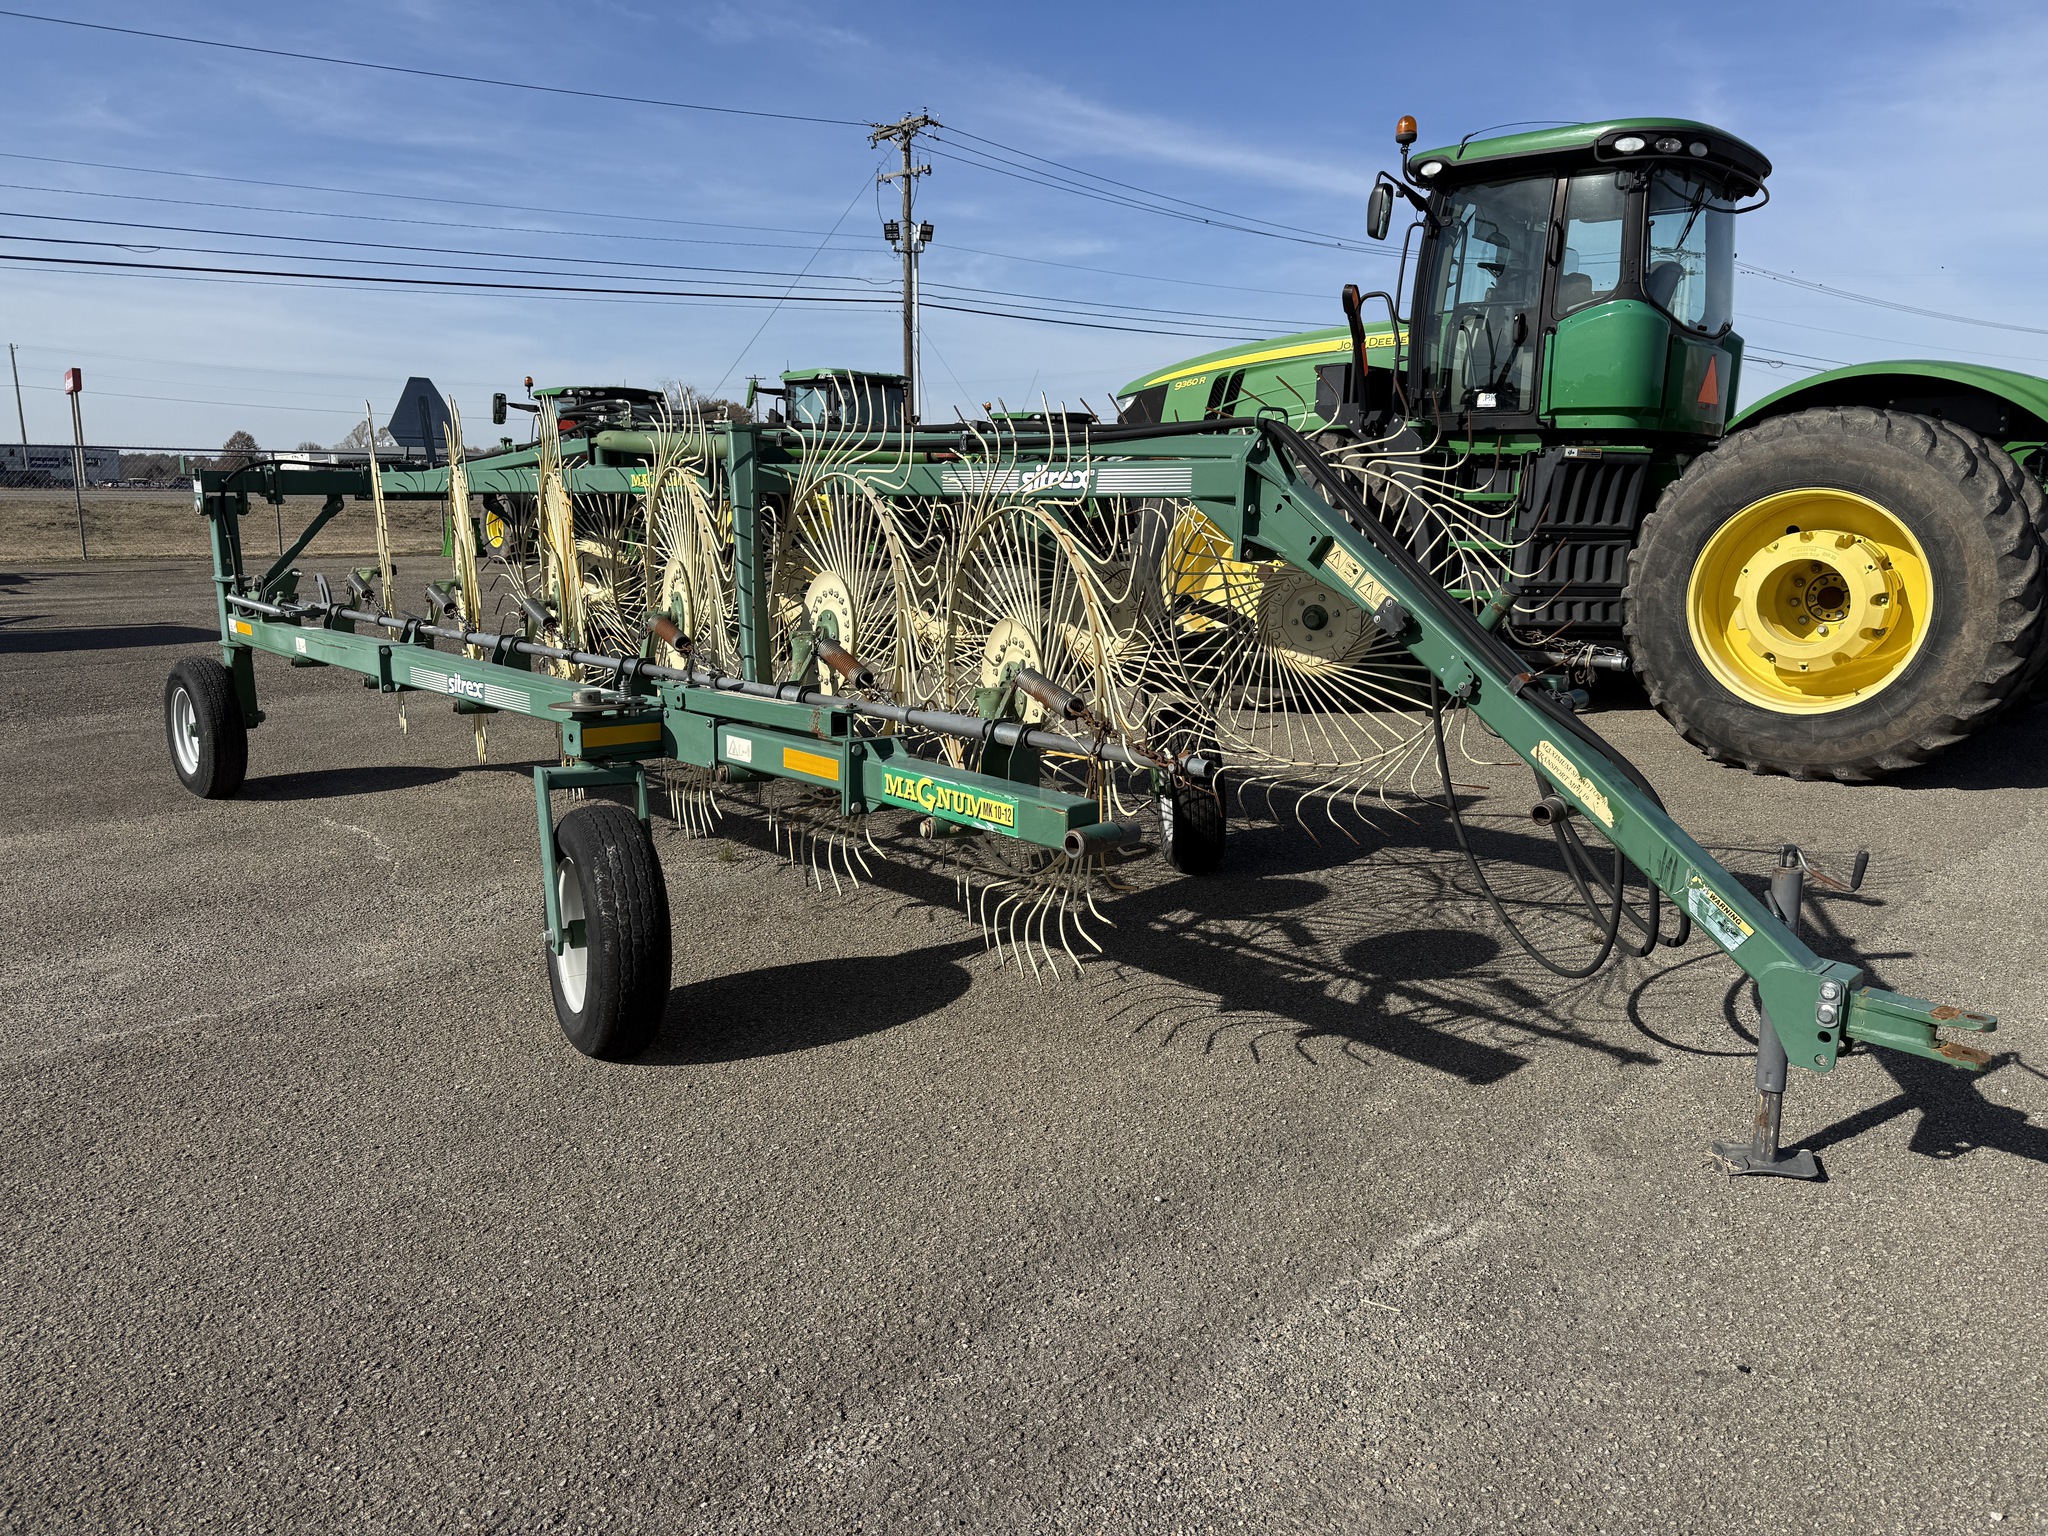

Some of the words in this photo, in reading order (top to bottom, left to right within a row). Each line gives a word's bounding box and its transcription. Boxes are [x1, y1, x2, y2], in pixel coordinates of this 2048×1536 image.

[1174, 378, 1199, 391] 9360
[1199, 376, 1207, 385] R
[1021, 464, 1093, 493] sitrex
[448, 672, 484, 699] sitrex
[1542, 742, 1573, 772] MAXIMUM
[884, 773, 982, 818] MAGNUM
[983, 804, 994, 818] MK
[994, 806, 1012, 823] 10-12
[1568, 779, 1583, 797] MPH
[1582, 792, 1591, 801] 19
[1709, 893, 1743, 926] WARNING
